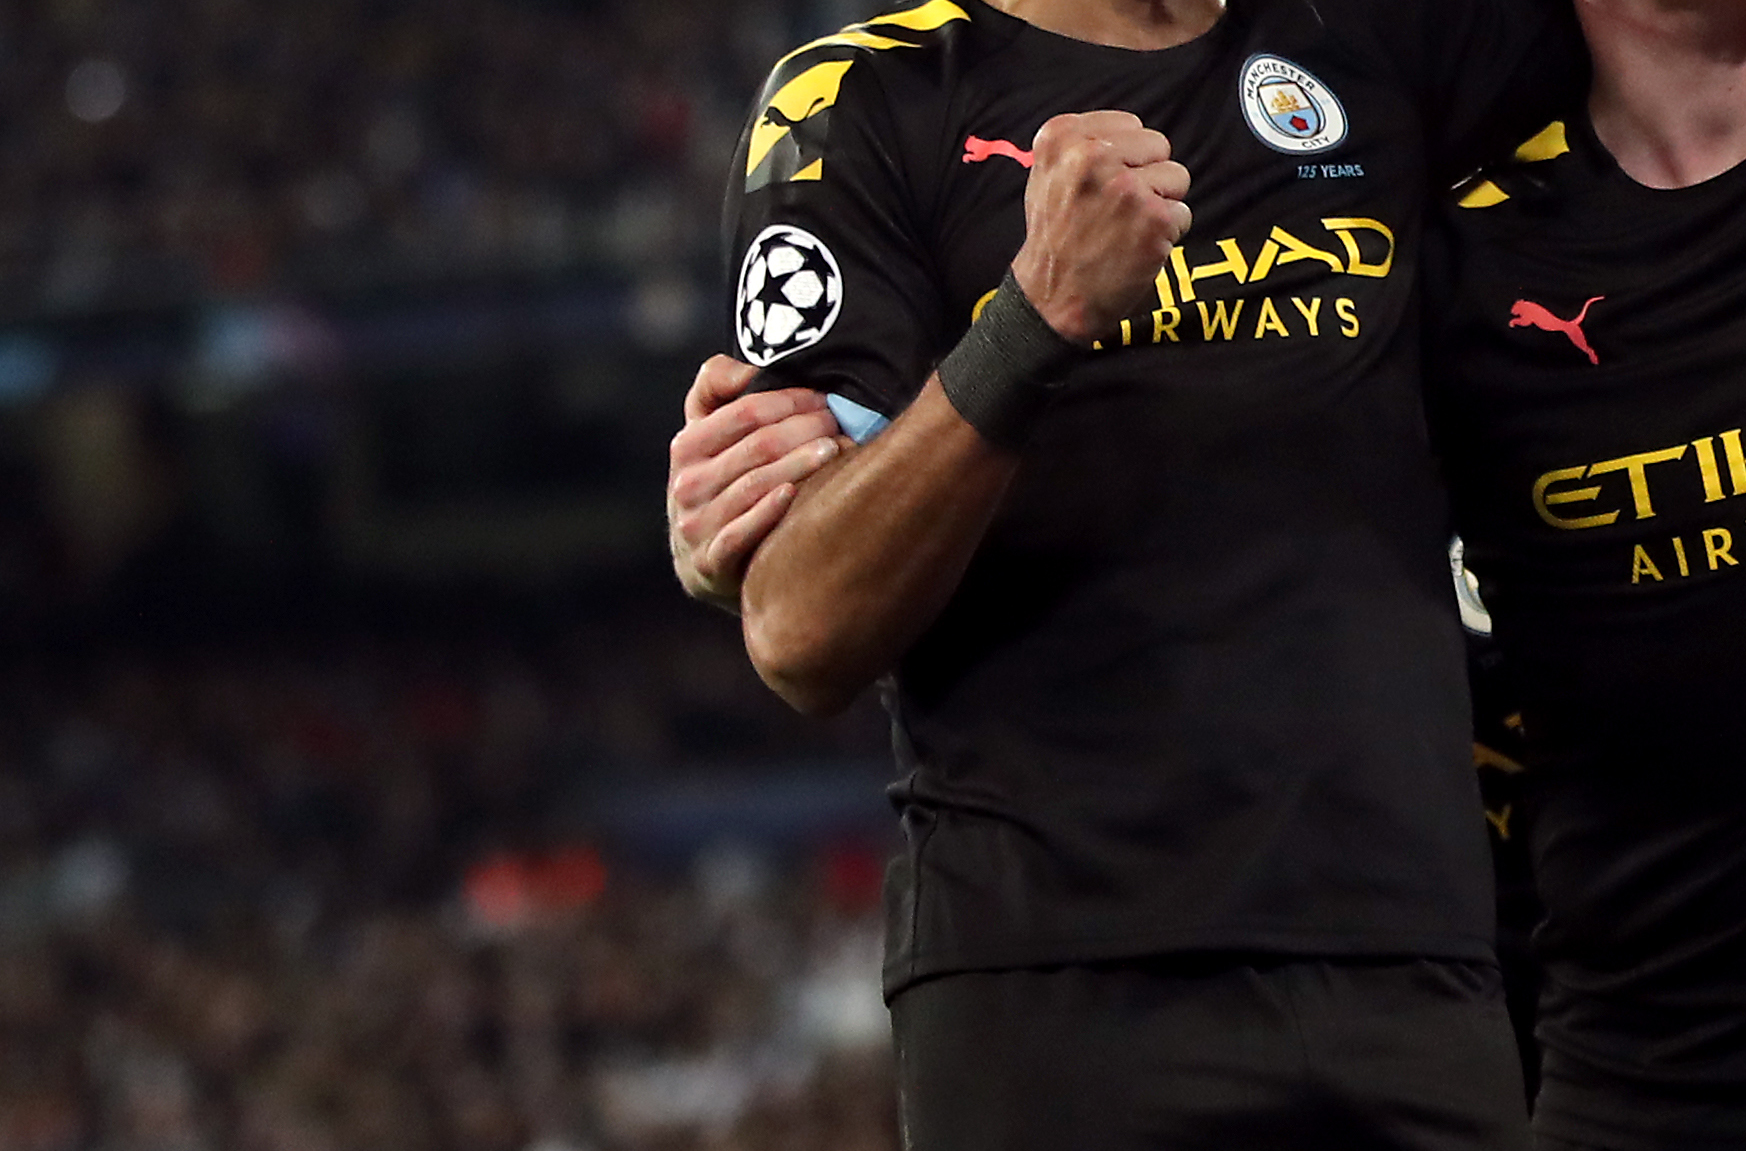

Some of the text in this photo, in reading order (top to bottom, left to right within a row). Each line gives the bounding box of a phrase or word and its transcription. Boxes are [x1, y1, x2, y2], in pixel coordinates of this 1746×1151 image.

[1247, 62, 1316, 100] MANCHESTER
[1302, 135, 1330, 149] CITY
[1297, 163, 1365, 179] 125 YEARS
[1093, 296, 1360, 350] IRWAYS
